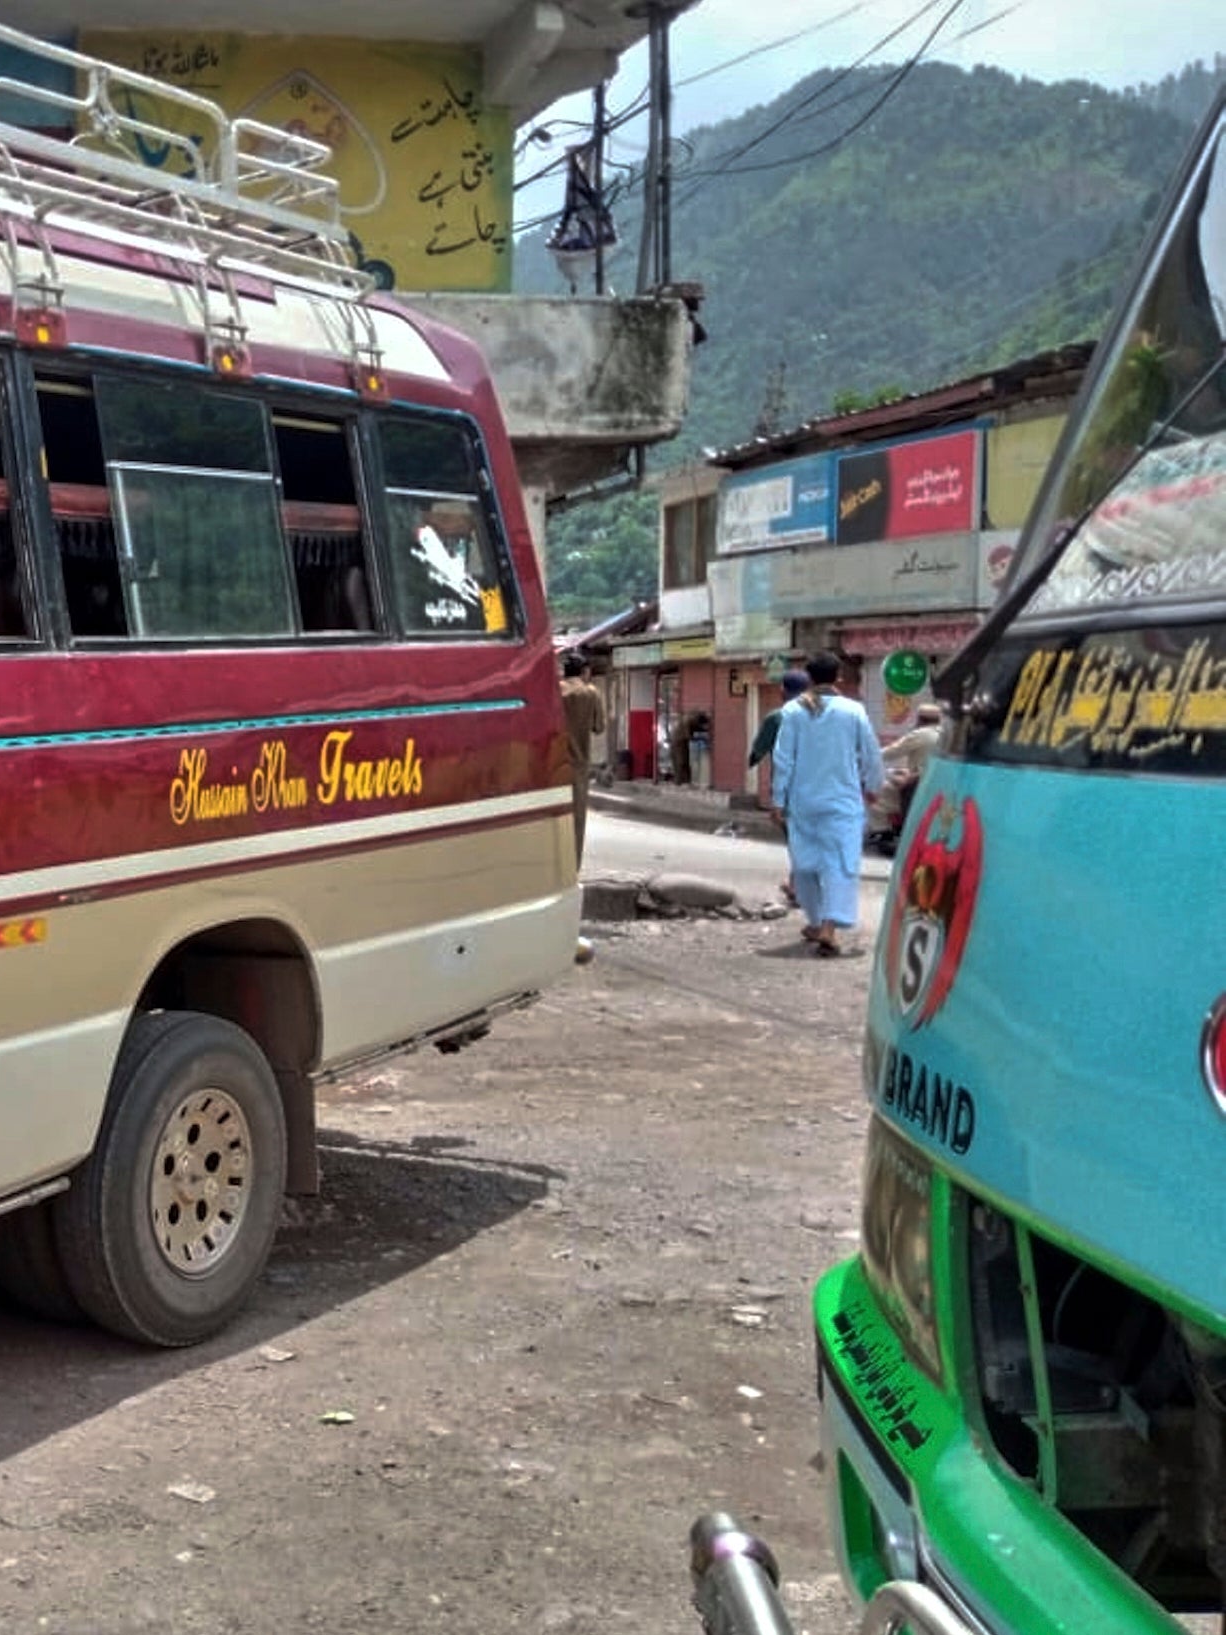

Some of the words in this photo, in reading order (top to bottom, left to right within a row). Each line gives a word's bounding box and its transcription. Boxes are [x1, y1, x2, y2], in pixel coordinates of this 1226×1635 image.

[251, 740, 308, 813] Khan
[317, 730, 423, 804] Travels
[901, 926, 928, 1004] S
